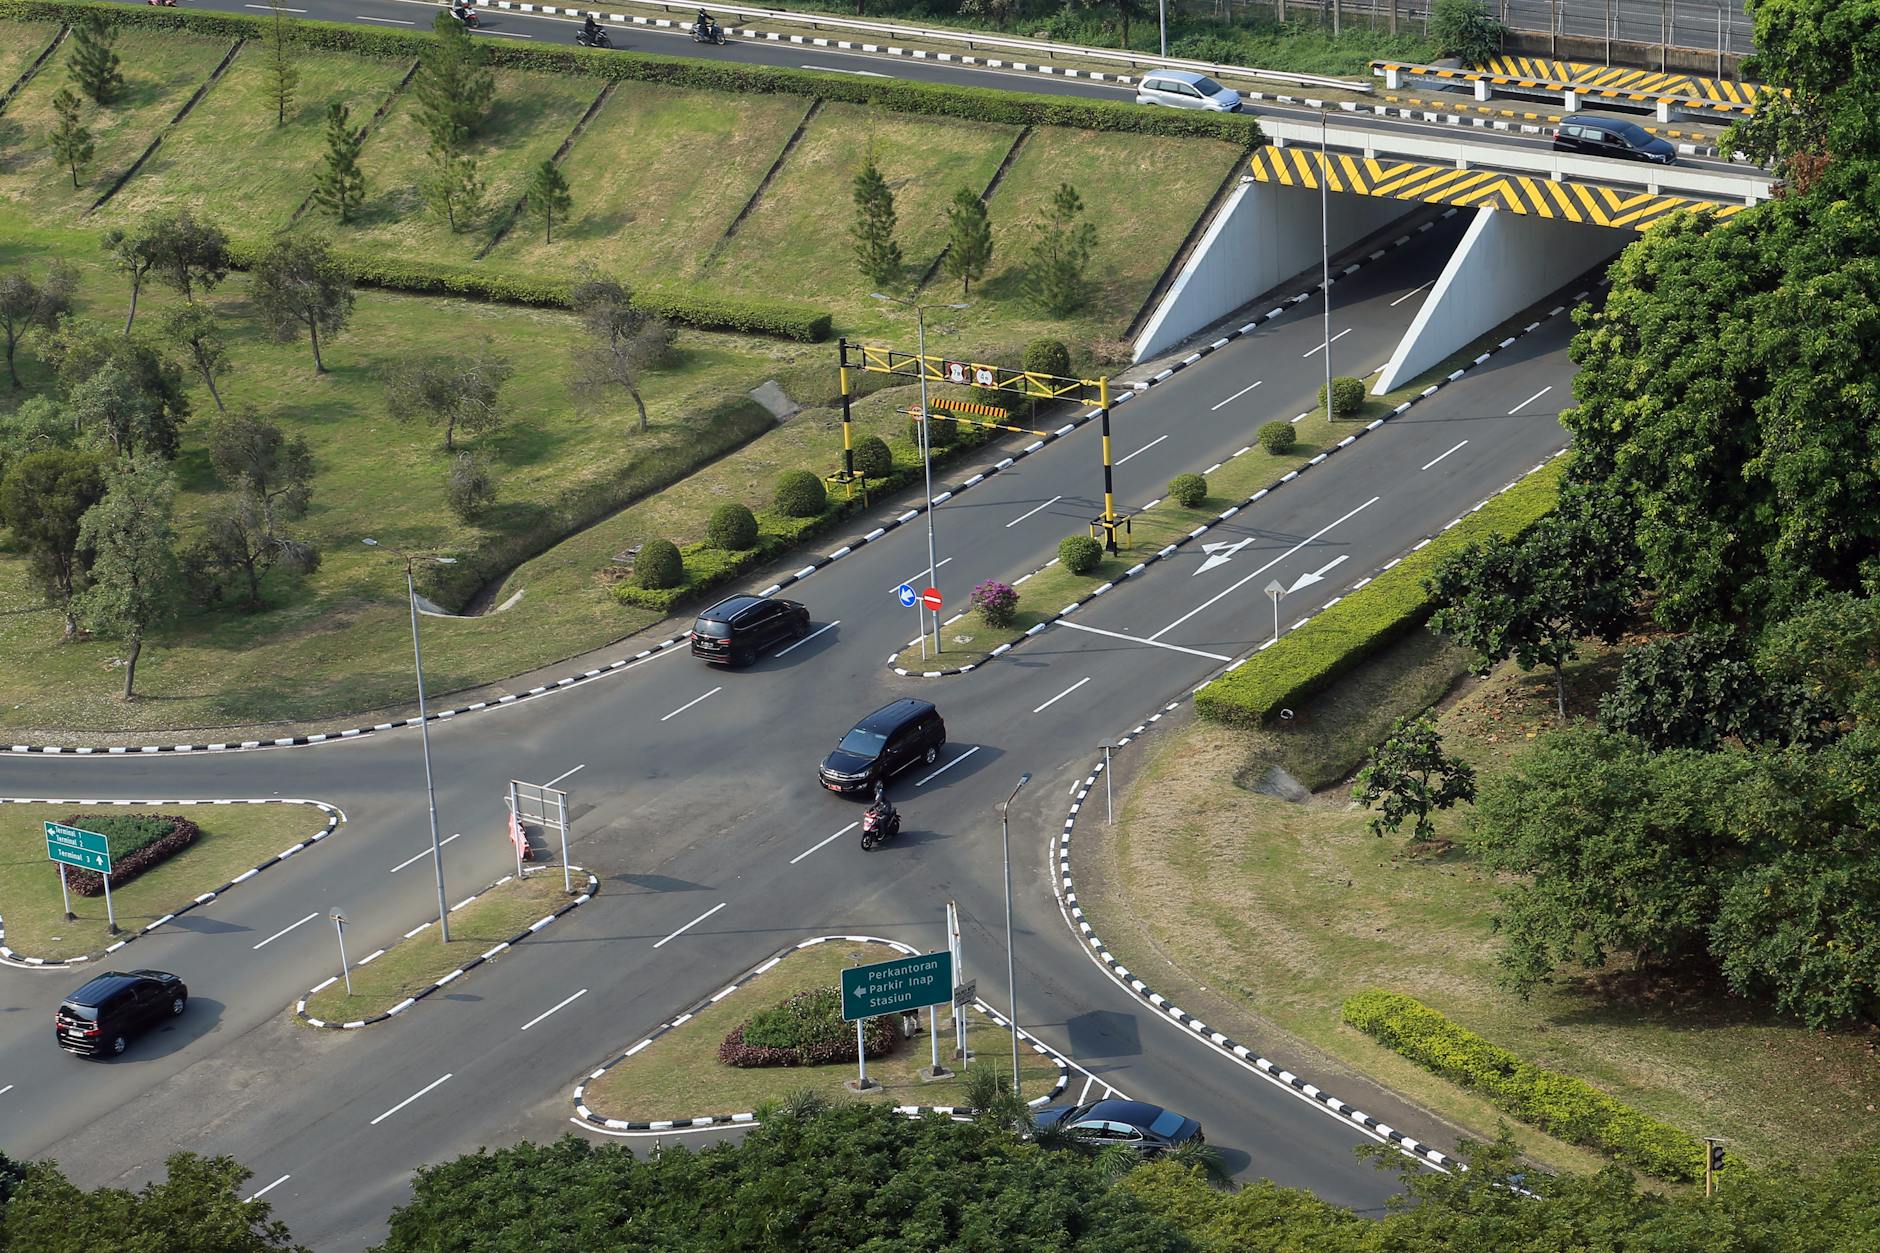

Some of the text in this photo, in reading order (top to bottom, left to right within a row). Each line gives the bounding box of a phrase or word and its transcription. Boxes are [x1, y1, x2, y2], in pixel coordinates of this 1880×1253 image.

[55, 826, 76, 837] Terminal
[56, 835, 77, 846] Terminal
[58, 849, 83, 861] Terminal
[868, 961, 938, 980] Perkantoran
[869, 975, 934, 993] Parkir Inap
[870, 992, 912, 1007] Stasiun
